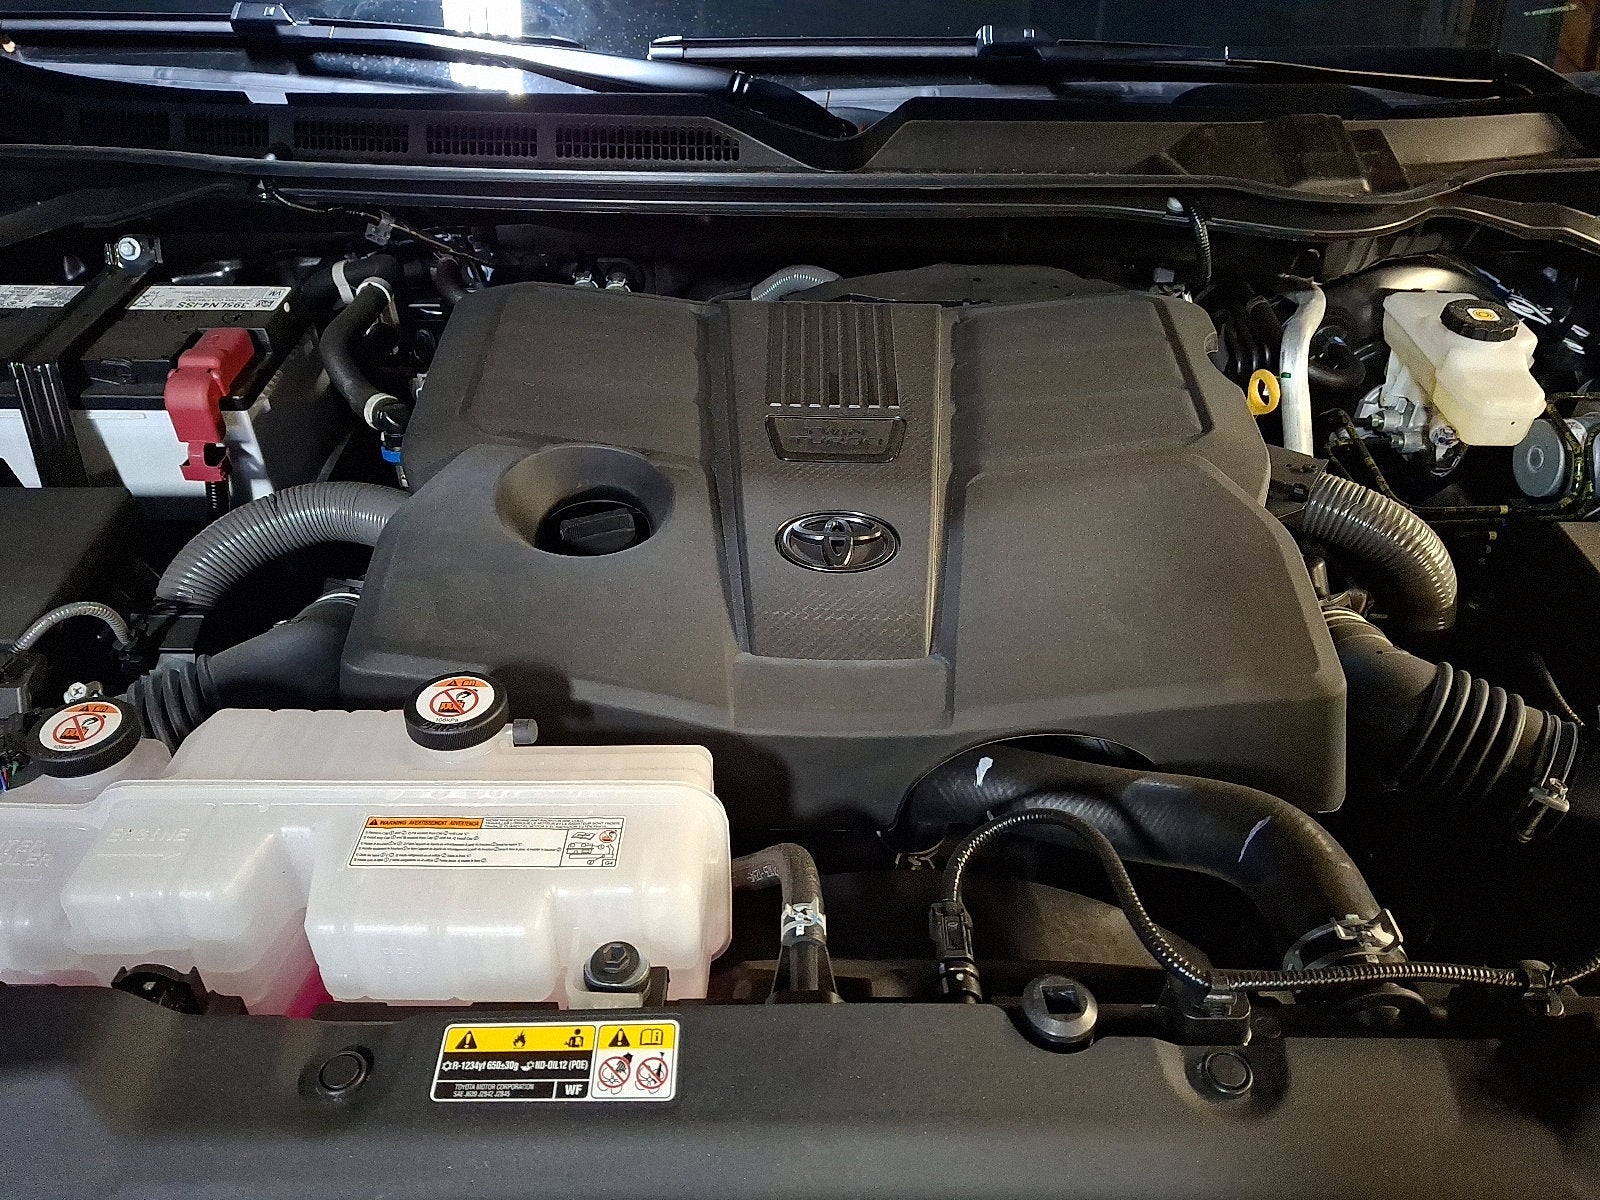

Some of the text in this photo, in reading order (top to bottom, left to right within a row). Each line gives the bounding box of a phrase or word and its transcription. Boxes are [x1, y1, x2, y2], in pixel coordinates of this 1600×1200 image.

[452, 1061, 486, 1072] R-1234yf
[486, 1060, 519, 1072] 650±30g
[568, 1060, 589, 1071] (POE)
[453, 1090, 465, 1098] SAE
[564, 1083, 584, 1096] WF
